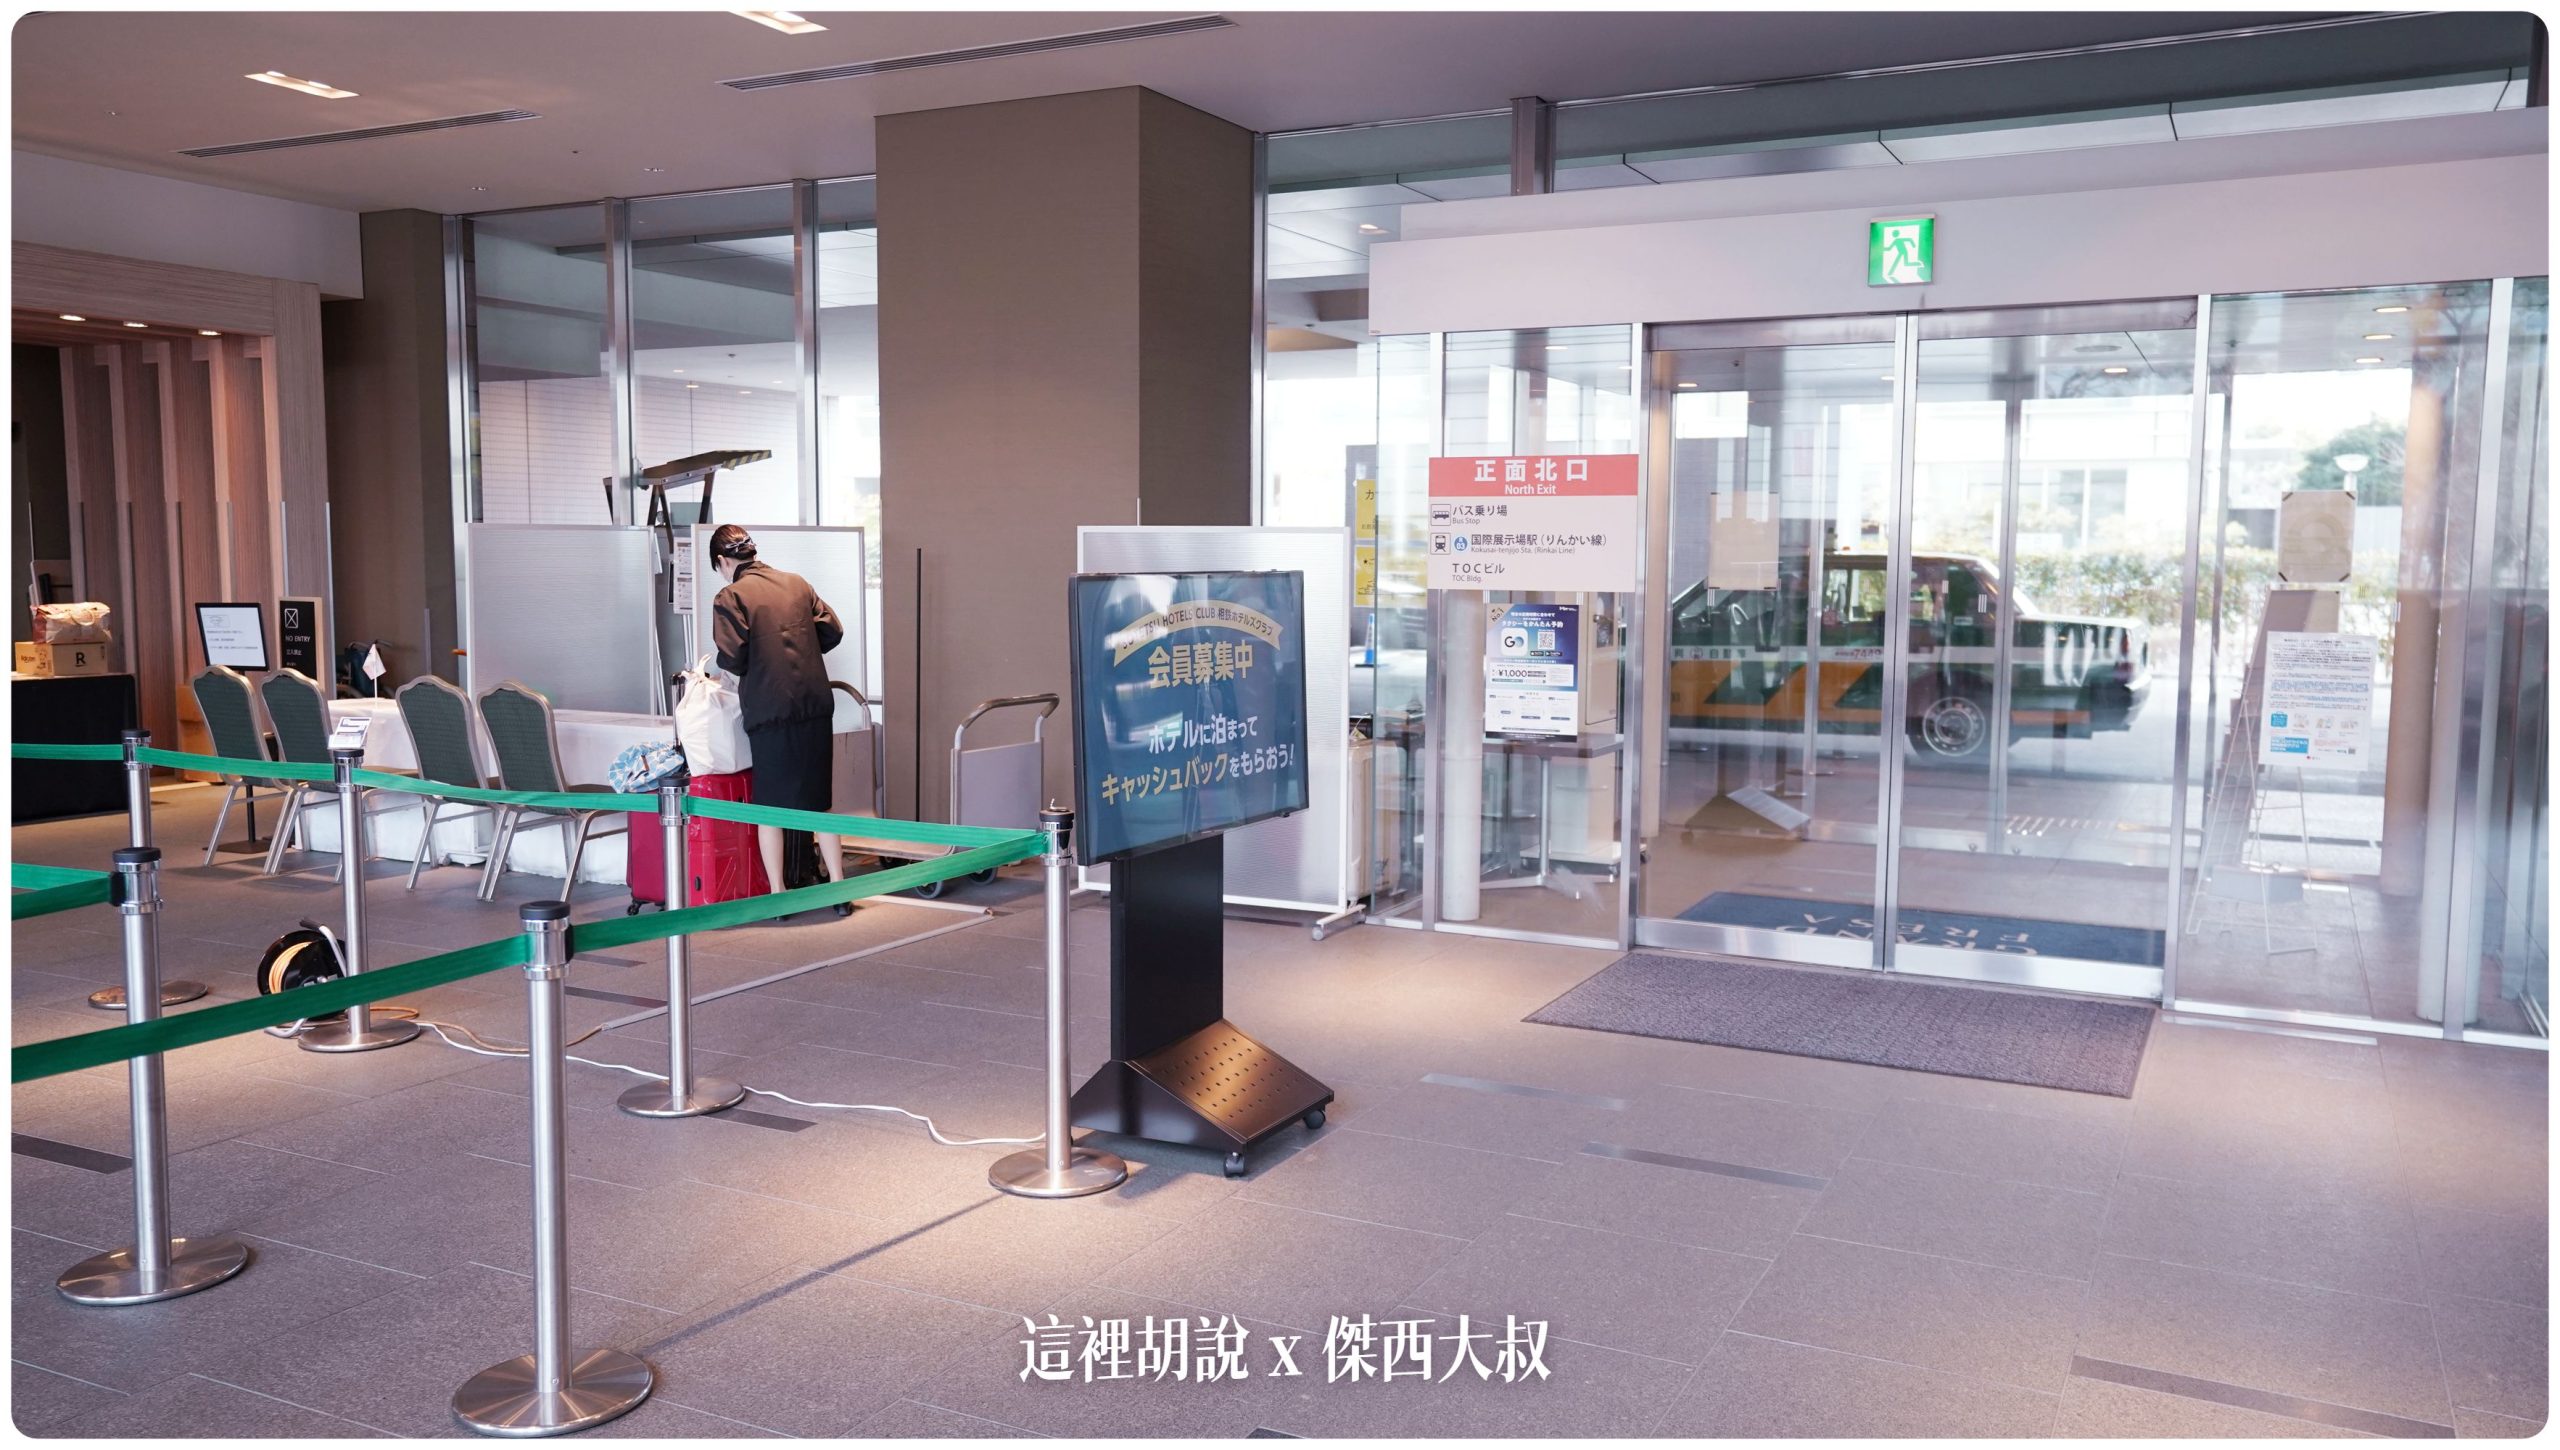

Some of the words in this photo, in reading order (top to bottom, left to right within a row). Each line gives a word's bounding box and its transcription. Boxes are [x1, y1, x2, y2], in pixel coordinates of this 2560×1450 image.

[1474, 459, 1588, 482] 正面北口
[1505, 484, 1534, 495] North
[1537, 484, 1557, 495] Exit
[1452, 504, 1508, 517] バス乗り場
[1452, 517, 1464, 525] Bus
[1465, 517, 1480, 526] Stop
[1534, 547, 1557, 555] (Rinkai
[1558, 547, 1576, 555] Line)
[1452, 563, 1505, 574] TOCビル
[1452, 574, 1466, 582] TOC
[1162, 609, 1193, 627] HOTELS
[1195, 607, 1216, 619] CLUB
[295, 635, 311, 643] ENTRY
[75, 651, 86, 666] R
[1148, 640, 1253, 688] 会員募集中
[1498, 669, 1528, 678] ¥1,000
[1149, 713, 1258, 754] ホテルに泊まって
[1102, 744, 1295, 806] キャッシュバックをもらおう!
